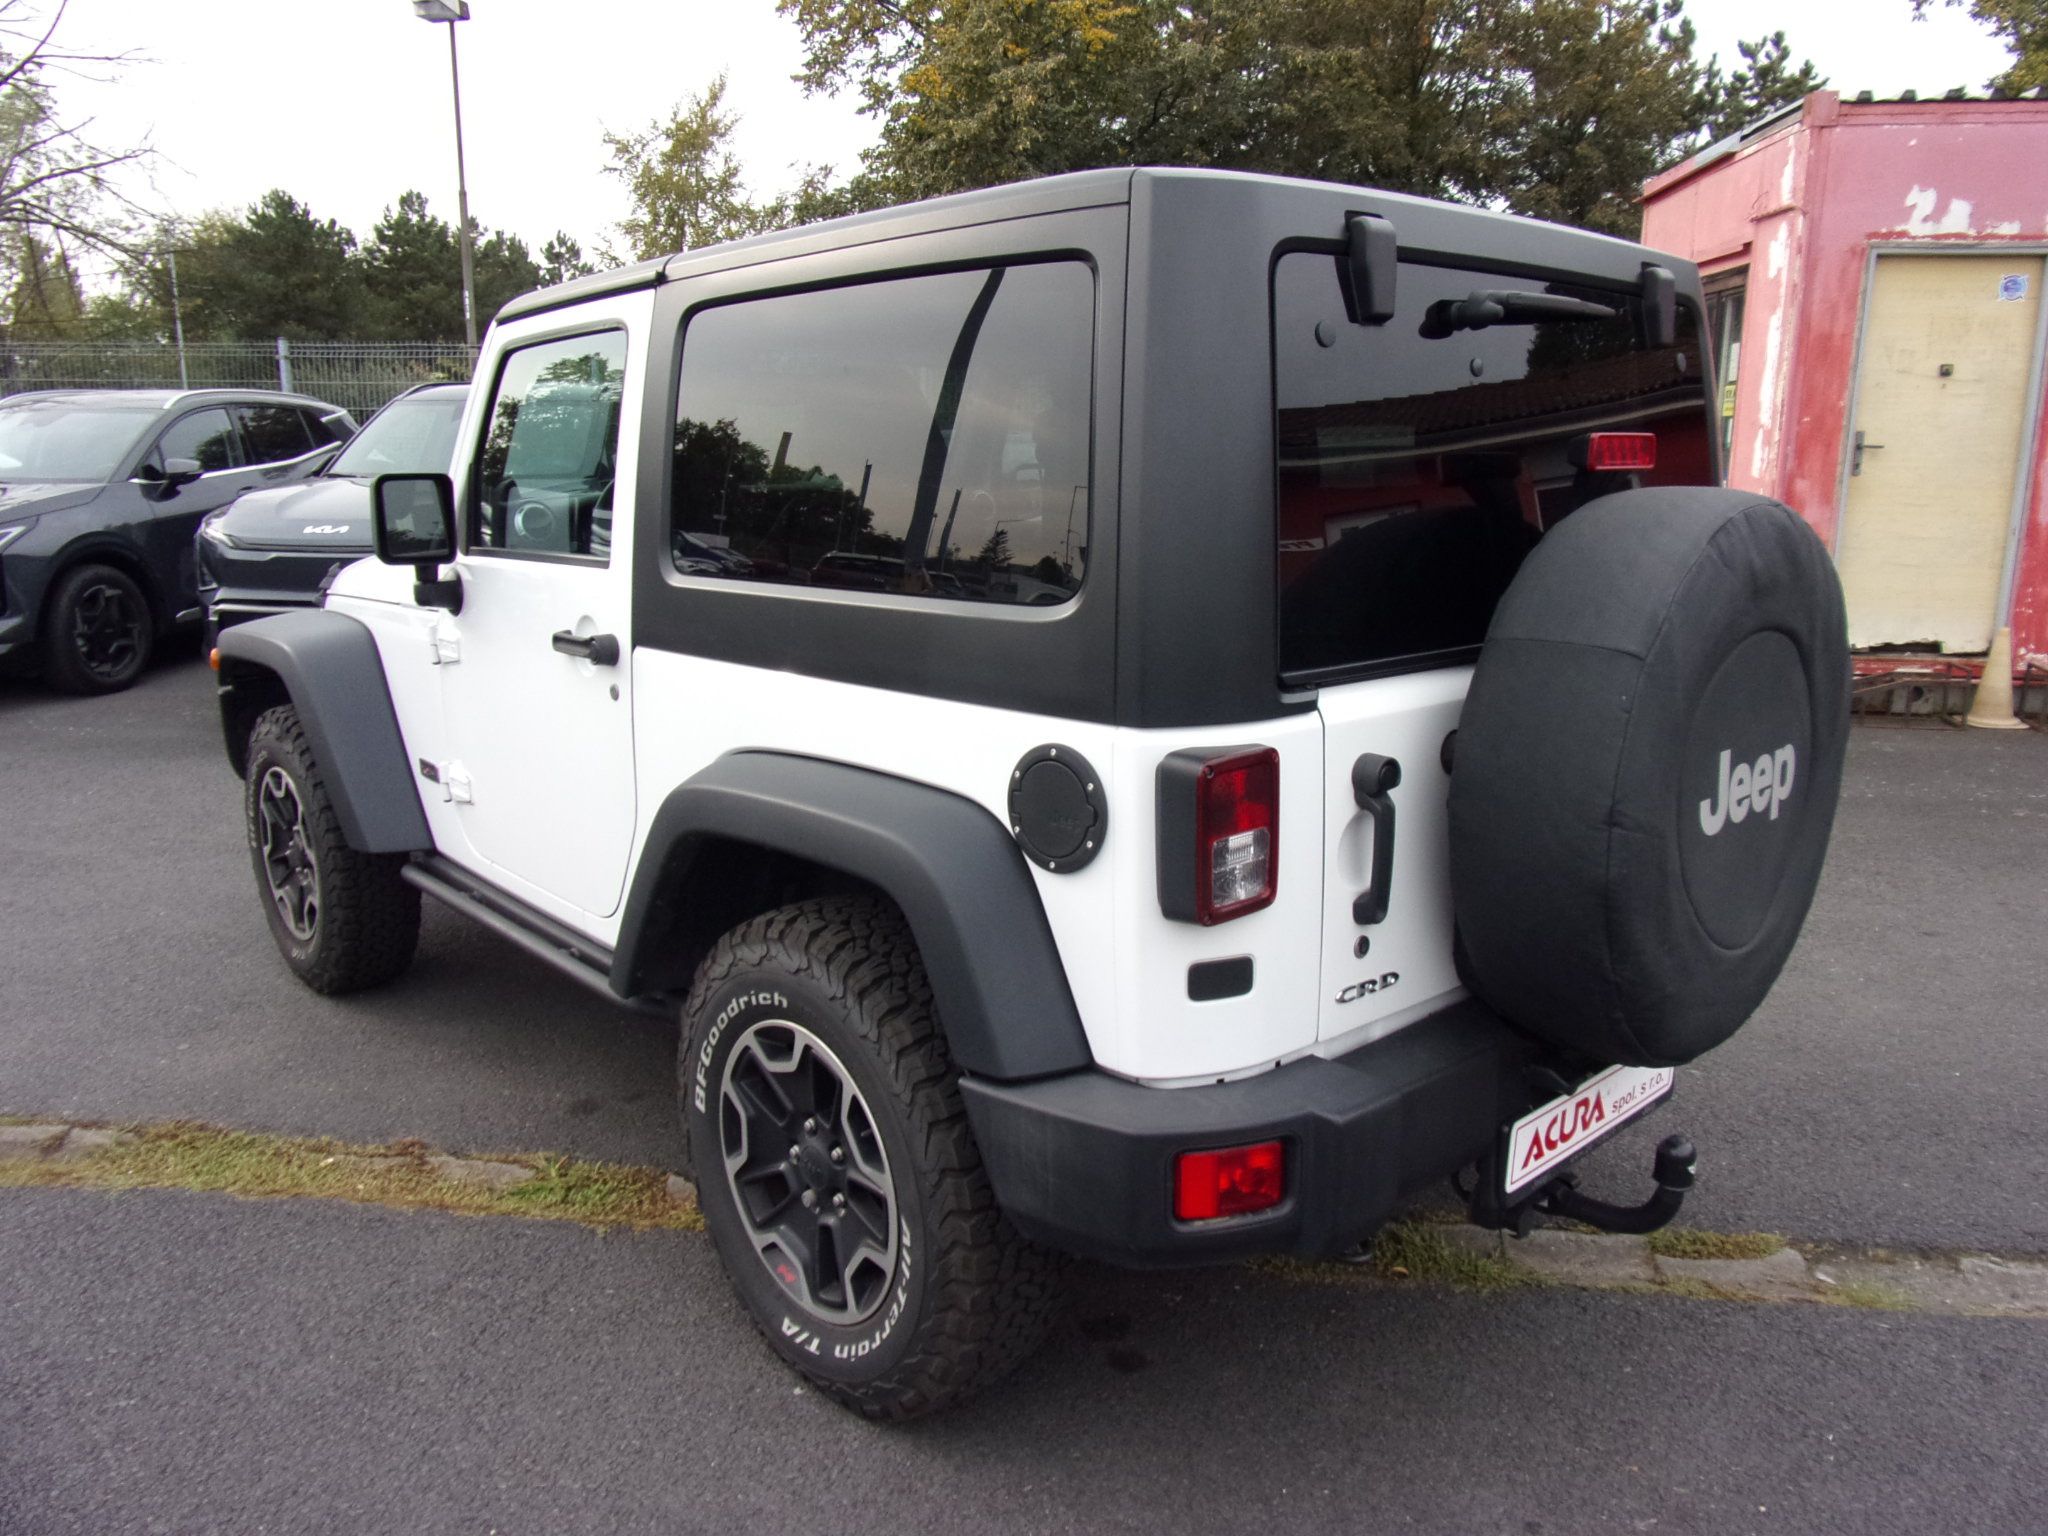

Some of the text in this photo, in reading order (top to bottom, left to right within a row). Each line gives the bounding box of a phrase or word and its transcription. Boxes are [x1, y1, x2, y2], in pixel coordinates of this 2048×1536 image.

[1700, 744, 1795, 836] Jeep
[1335, 971, 1400, 1003] CRD
[695, 990, 788, 1114] BFGoodrich
[1521, 1073, 1664, 1169] ACURA spol. s r.o.
[781, 1216, 911, 1362] All-Terrain T/A
